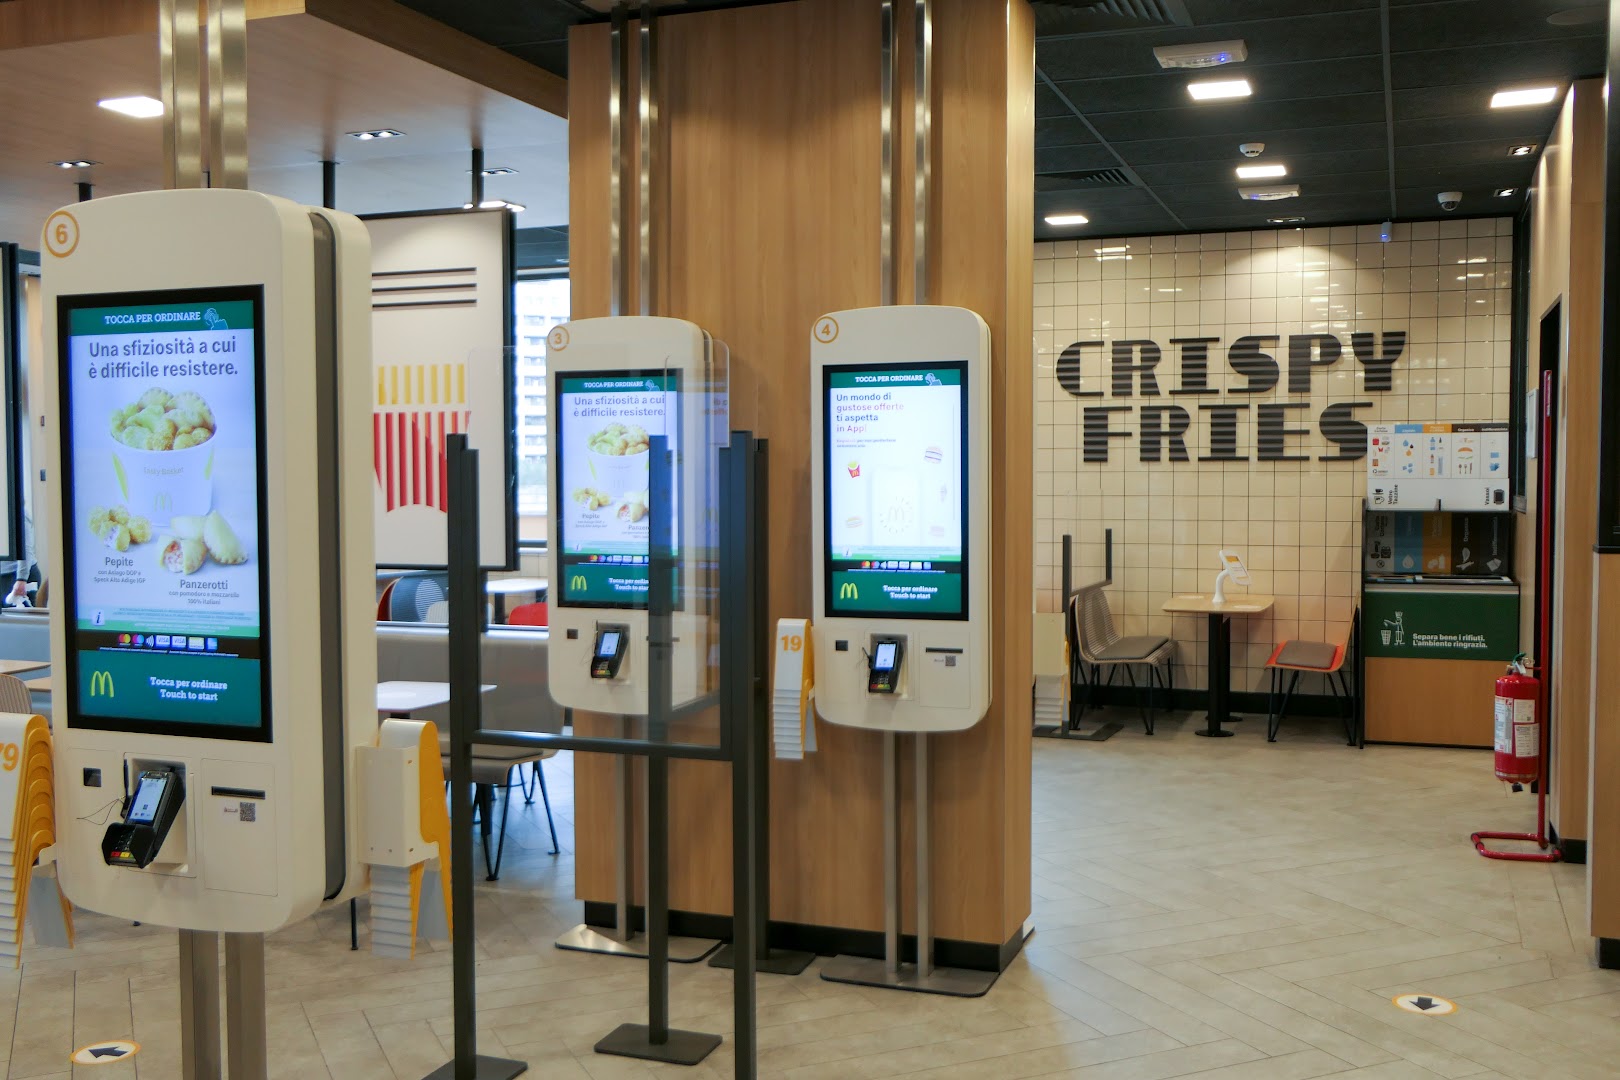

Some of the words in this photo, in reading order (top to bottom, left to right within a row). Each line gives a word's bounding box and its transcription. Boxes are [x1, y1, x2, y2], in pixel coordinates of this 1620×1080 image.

[55, 224, 68, 245] 6
[104, 315, 135, 324] TOCCA
[136, 314, 153, 323] PER
[154, 312, 201, 322] ORDINARE
[821, 323, 831, 336] 4
[554, 332, 563, 345] 3
[89, 342, 118, 358] Una
[123, 336, 195, 356] sfiziosità
[200, 341, 208, 354] a
[212, 336, 236, 354] cui
[88, 362, 98, 378] è
[101, 361, 160, 378] difficile
[163, 360, 238, 377] resistere.
[1056, 331, 1406, 396] CRISPY
[615, 380, 644, 388] ORDINARE
[890, 374, 924, 382] ORDINARE
[574, 396, 592, 406] Una
[595, 394, 640, 406] sfiziosità
[650, 394, 665, 404] cui
[836, 394, 848, 402] Un
[850, 392, 881, 401] mondo
[882, 392, 892, 400] di
[574, 408, 580, 417] è
[582, 407, 618, 417] difficile
[620, 407, 666, 416] resistere.
[836, 404, 872, 413] gustose
[874, 402, 904, 411] offerte
[836, 414, 843, 422] ti
[844, 414, 878, 424] aspetta
[1083, 402, 1373, 462] FRIES
[105, 556, 134, 568] Pepite
[180, 579, 229, 590] Panzerotti
[781, 635, 802, 652] 19
[1413, 633, 1438, 642] Separa
[1462, 634, 1485, 642] rifiuti.
[1453, 640, 1488, 649] ringrazia.
[150, 676, 175, 687] Tocca
[176, 680, 190, 690] per
[191, 680, 228, 690] ordinare
[160, 688, 187, 700] Touch
[188, 690, 197, 700] to
[198, 692, 218, 702] start
[0, 742, 20, 772] 9
